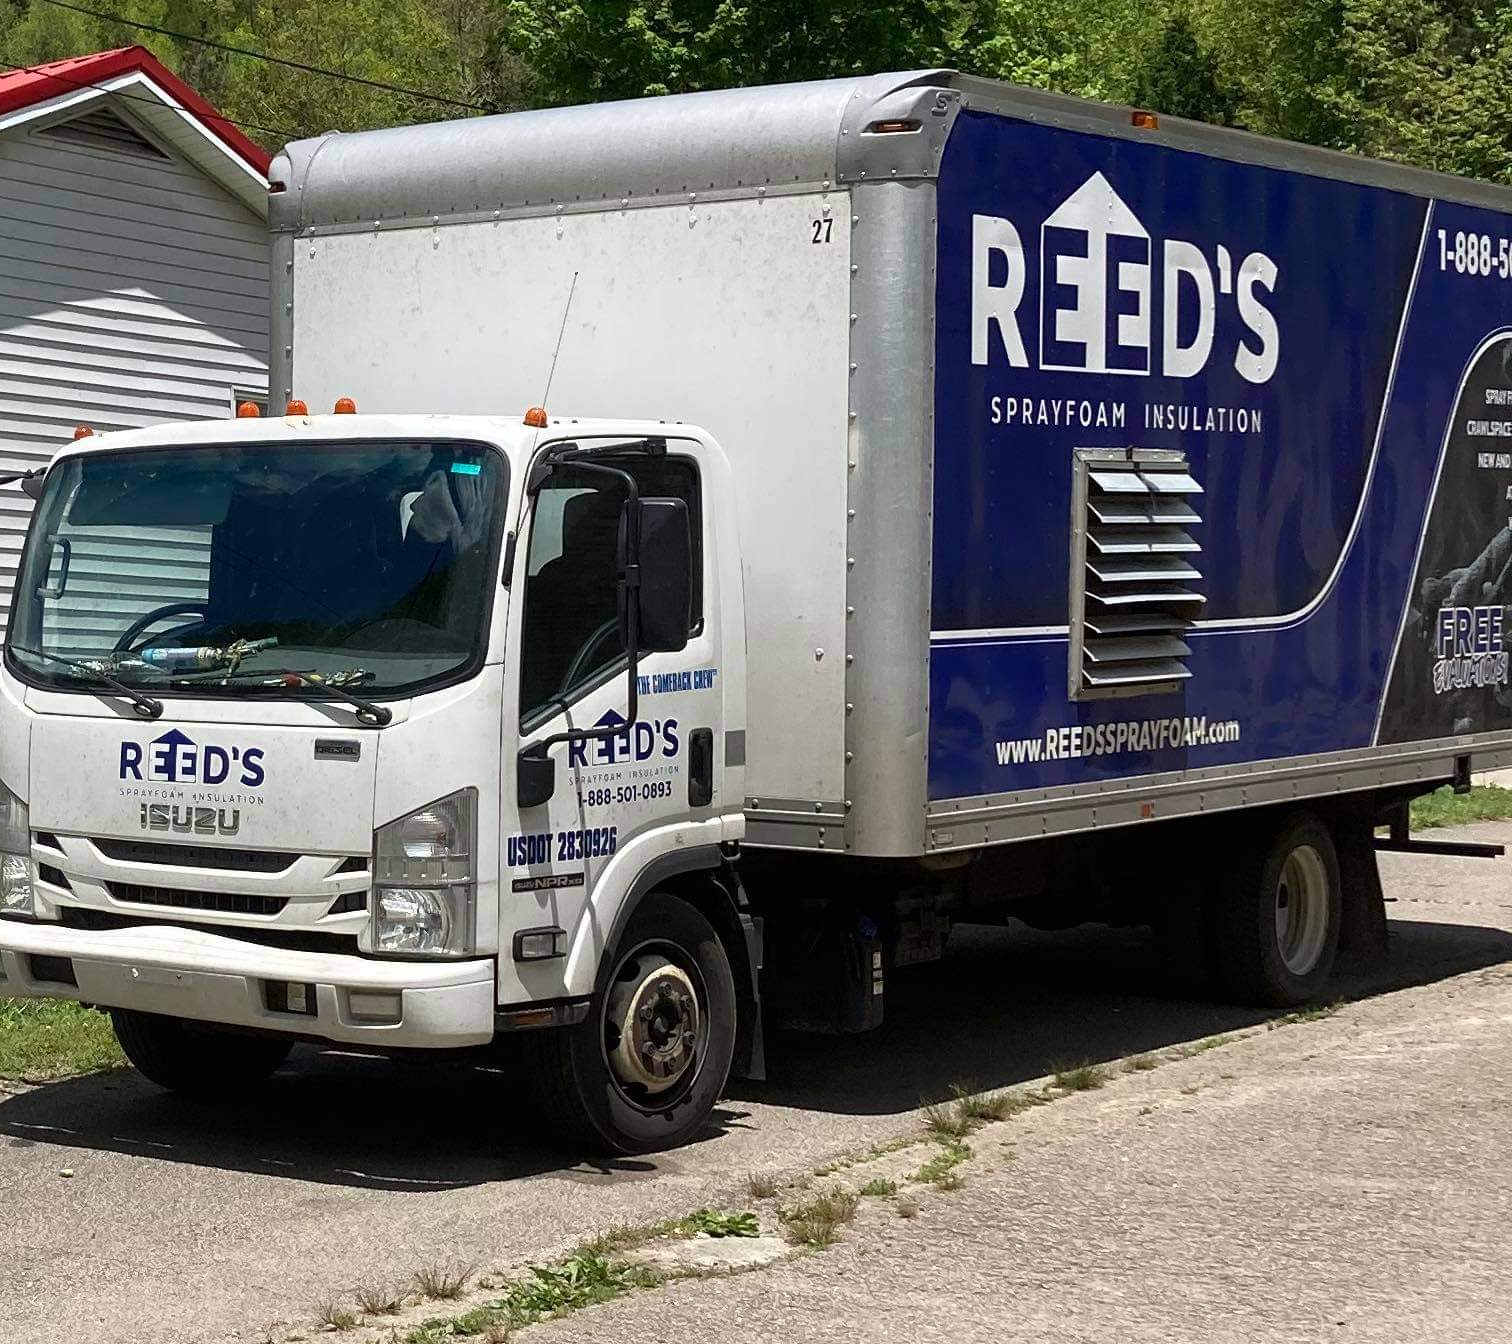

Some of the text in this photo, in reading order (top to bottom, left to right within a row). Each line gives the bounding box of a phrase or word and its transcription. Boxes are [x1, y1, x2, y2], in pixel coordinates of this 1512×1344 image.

[812, 218, 833, 244] 27
[971, 171, 1279, 384] REED'S
[991, 396, 1262, 433] SPRAYFOAM INSULATION
[1478, 453, 1511, 469] NEW AND
[1438, 605, 1503, 659] FREE
[652, 671, 691, 693] COMEBACK
[568, 709, 680, 768] REED'S
[996, 717, 1240, 765] www.REEDSSPRAYFOAM.com
[119, 728, 265, 787] REED'S
[568, 765, 680, 786] SPRAYFOAM INSULATION
[119, 788, 264, 805] SPRAYFOAM INSULATION
[578, 781, 672, 808] 1-888-501-0893
[140, 803, 240, 836] ISUZU
[507, 826, 618, 867] USDOT 2830926
[535, 876, 568, 889] NPR
